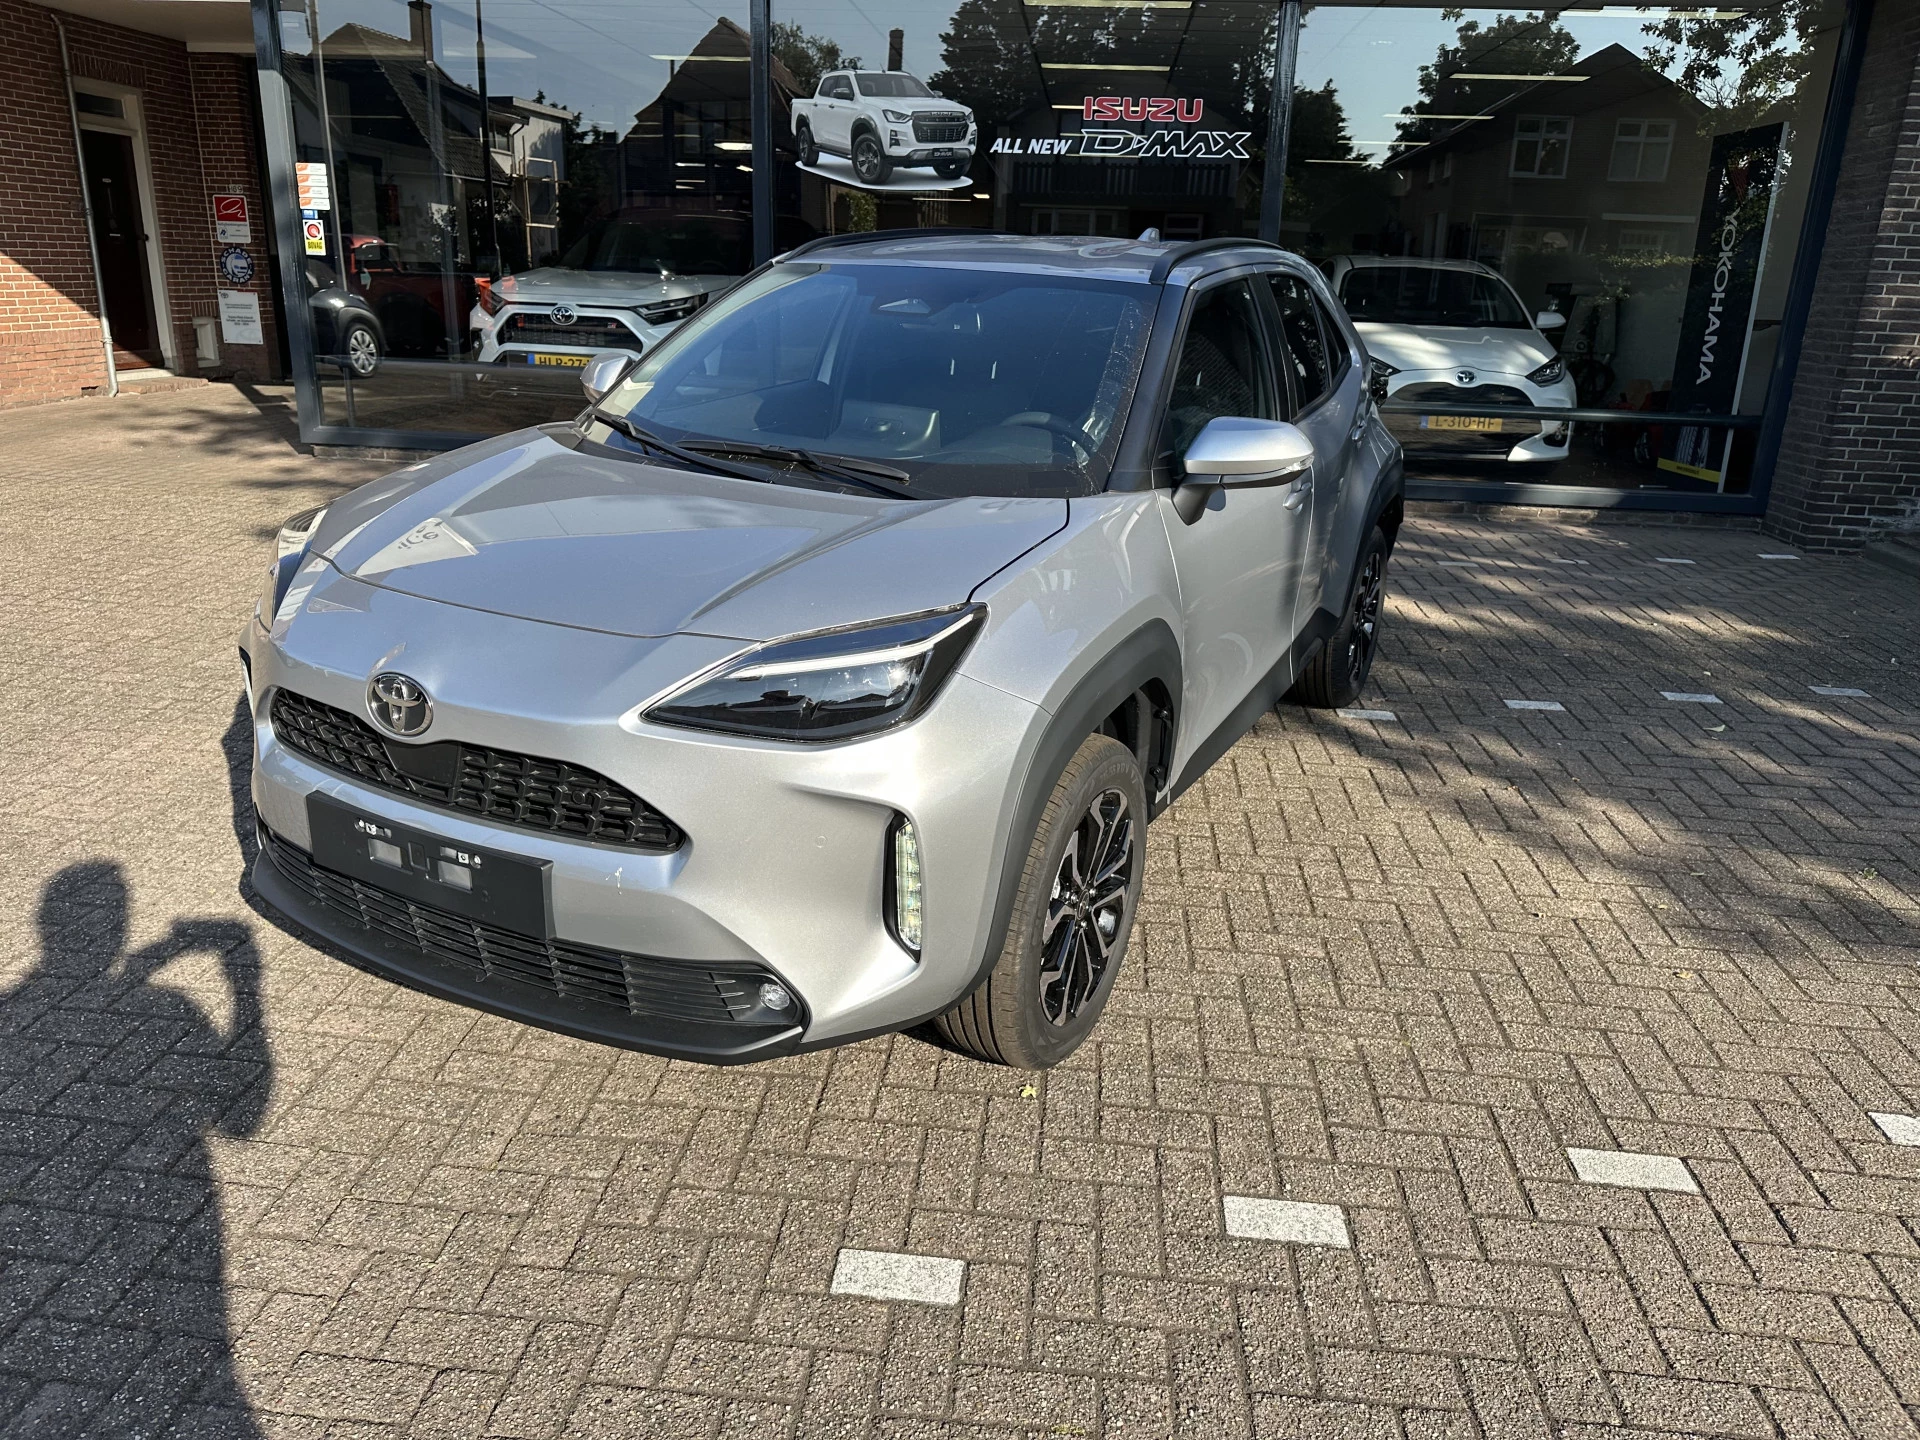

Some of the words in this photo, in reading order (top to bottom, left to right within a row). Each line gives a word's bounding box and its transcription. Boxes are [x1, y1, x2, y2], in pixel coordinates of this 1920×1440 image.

[1082, 96, 1203, 123] ISUZU
[989, 137, 1024, 154] ALL
[1027, 138, 1072, 156] NEW
[307, 241, 323, 250] BOVAG
[1695, 207, 1741, 385] YOKOHAMA
